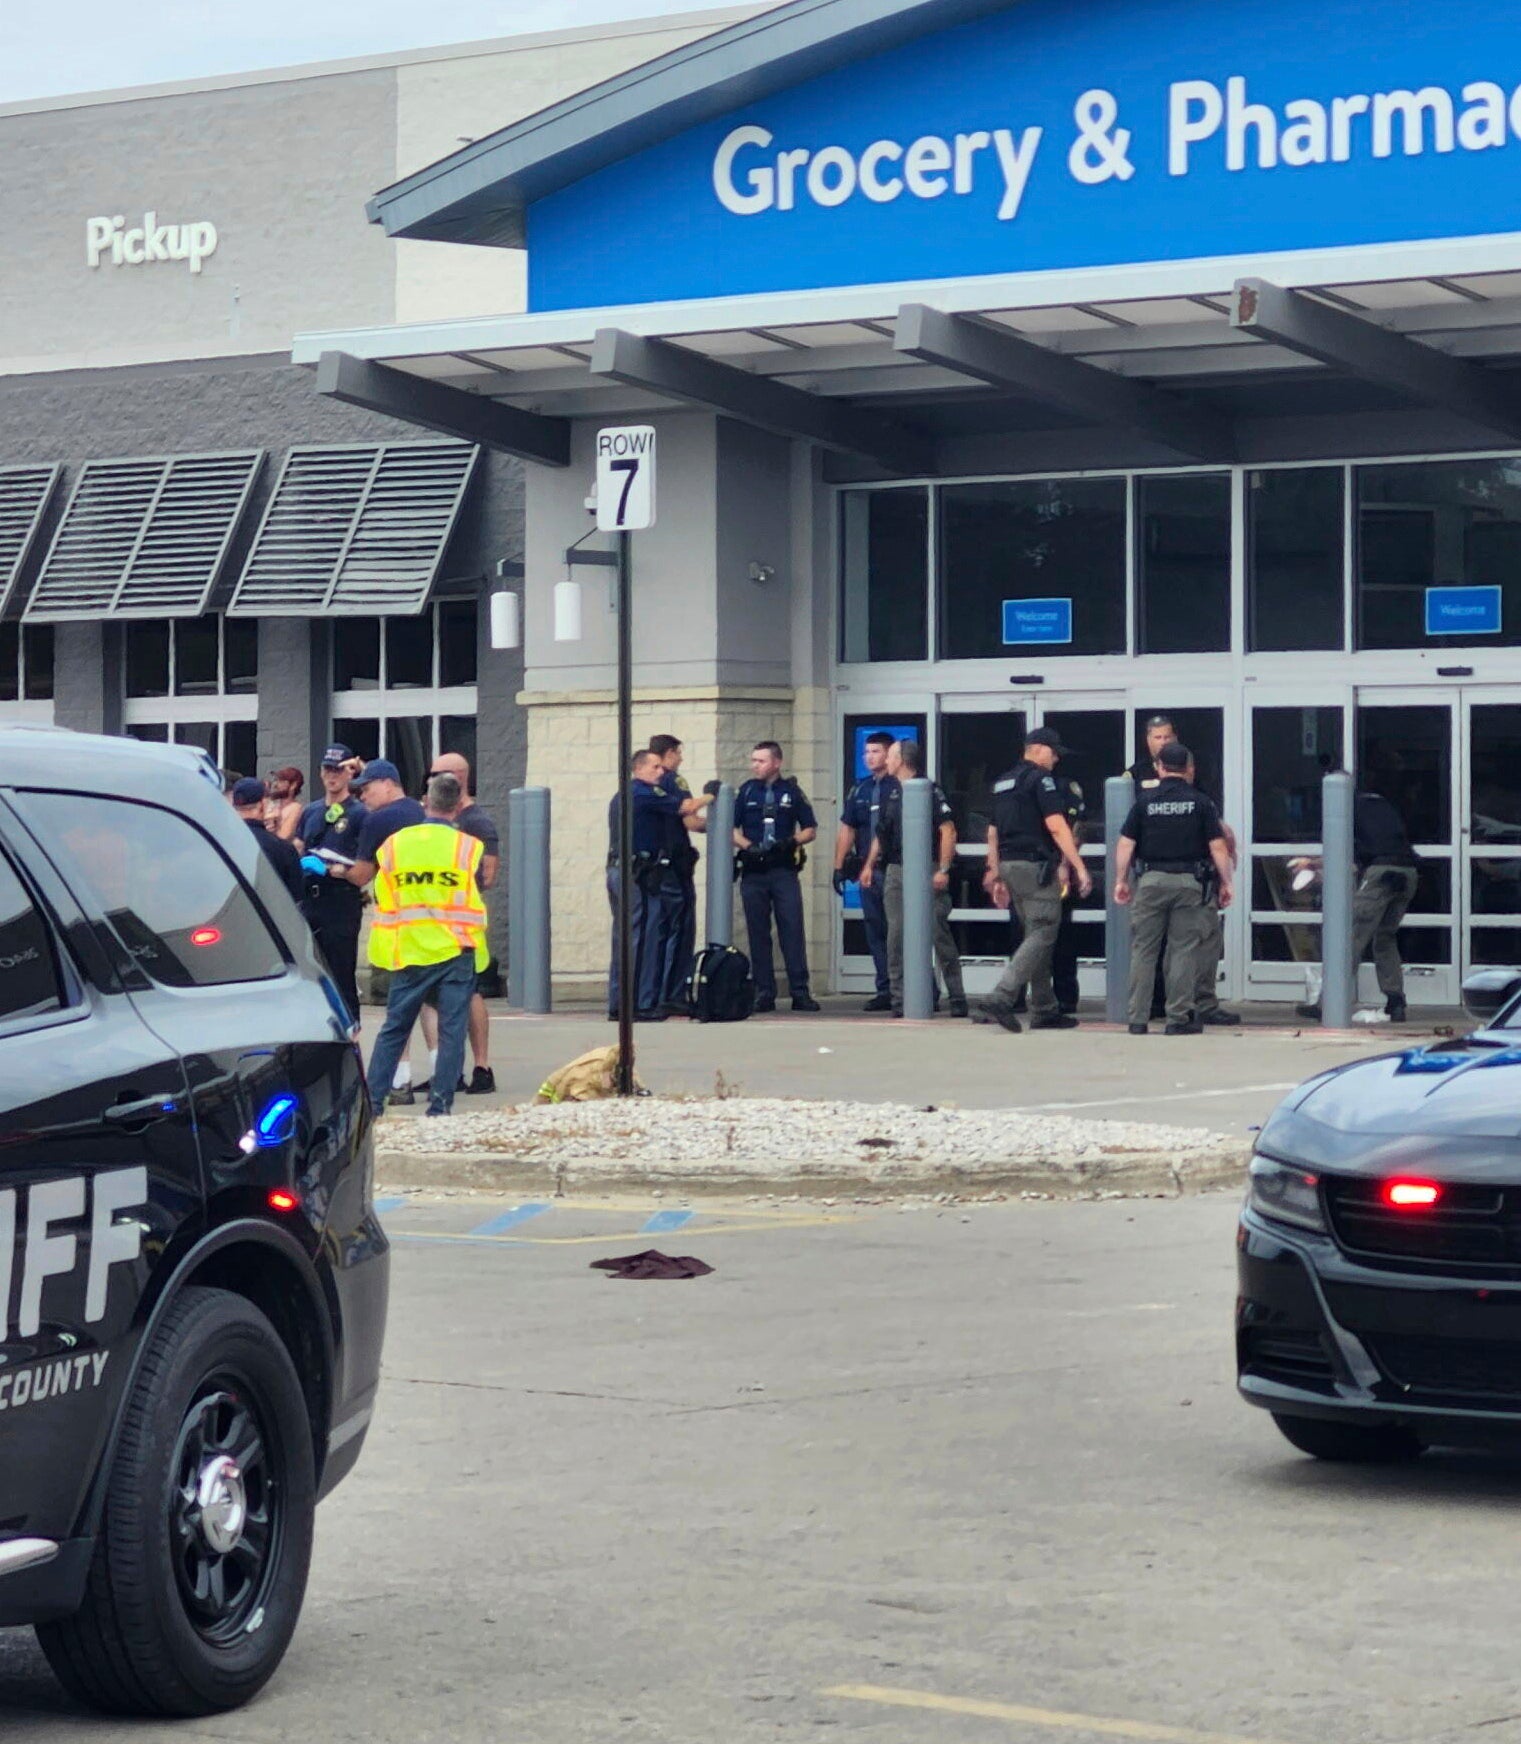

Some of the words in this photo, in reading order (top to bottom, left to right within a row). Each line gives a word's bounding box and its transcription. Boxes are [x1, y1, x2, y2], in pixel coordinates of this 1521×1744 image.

[712, 124, 1043, 220] Grocery
[1068, 88, 1135, 184] &
[1169, 75, 1521, 176] Pharma
[86, 210, 218, 273] Pickup
[599, 433, 647, 456] ROW
[610, 459, 639, 526] 7
[1147, 801, 1196, 816] SHERIFF
[395, 871, 459, 888] EMS
